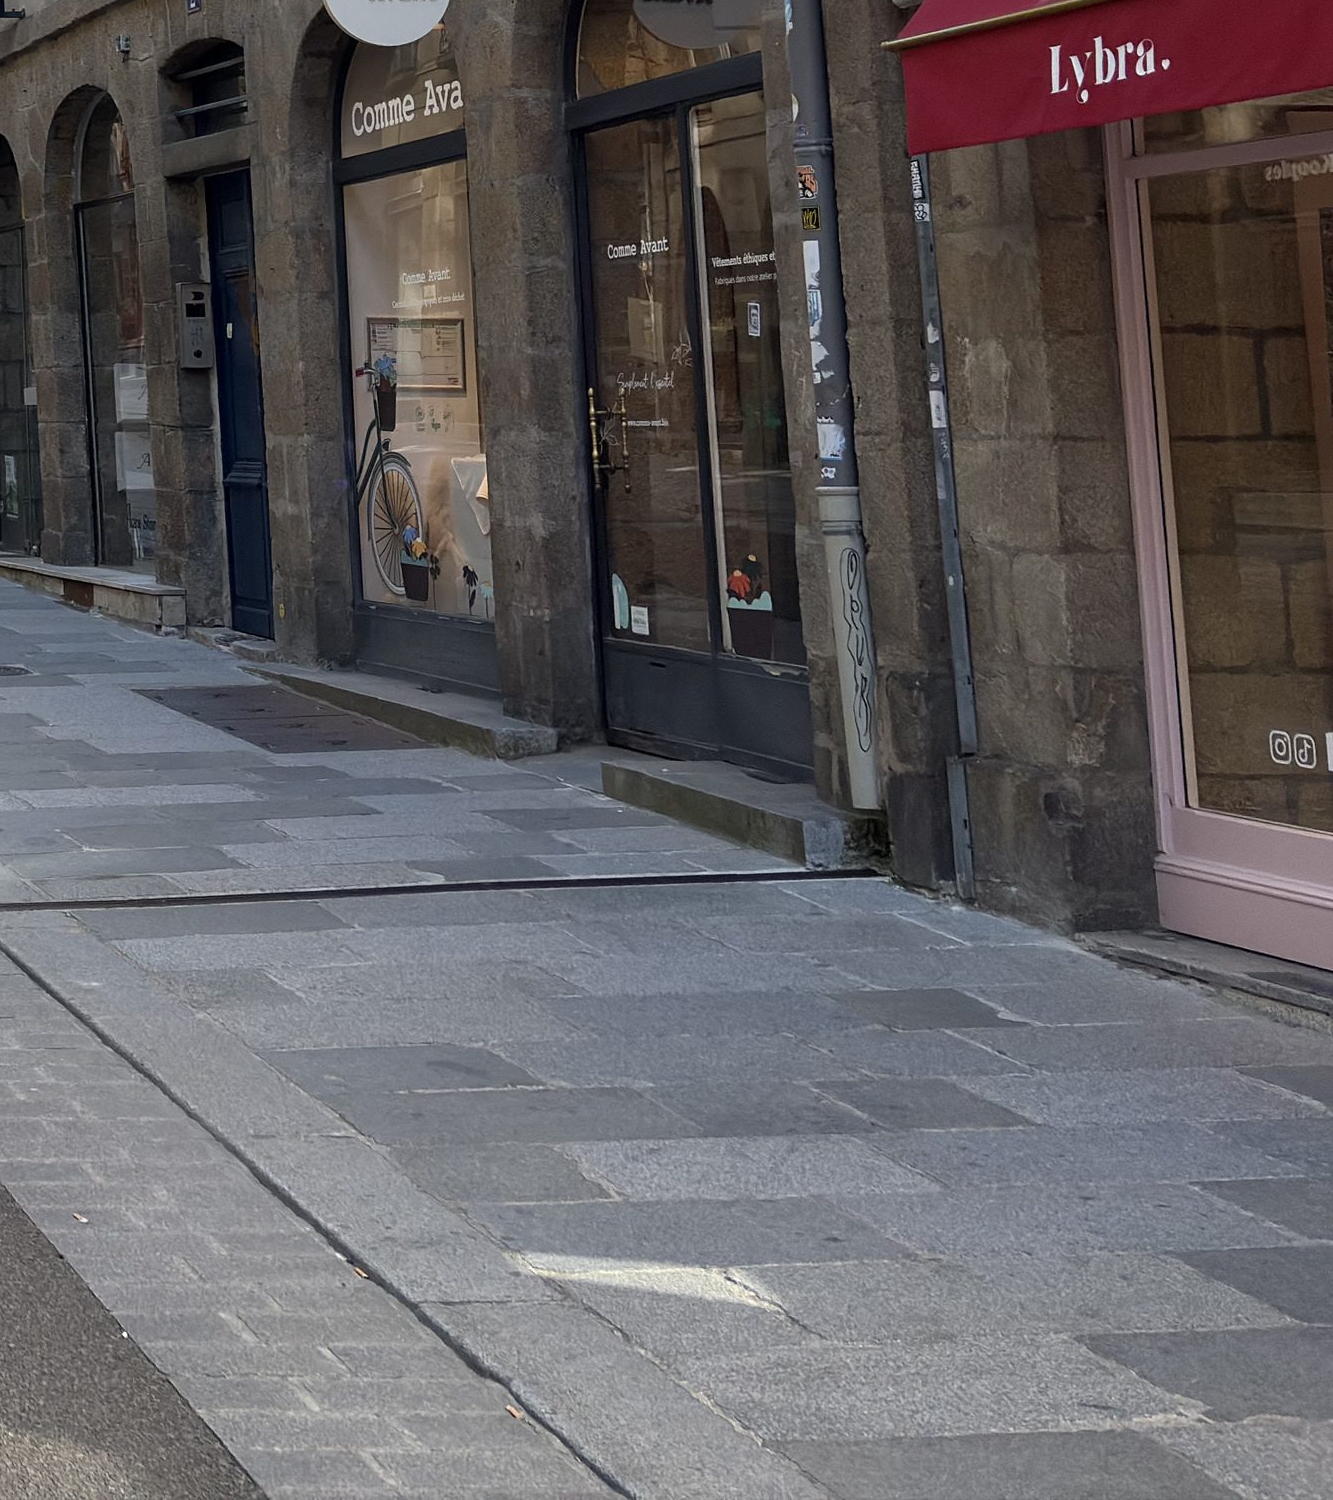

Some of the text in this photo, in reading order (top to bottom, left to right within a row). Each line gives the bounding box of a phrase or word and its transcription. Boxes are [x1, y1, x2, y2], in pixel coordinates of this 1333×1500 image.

[351, 79, 464, 137] Comme Ava
[607, 236, 669, 260] Comme Avant
[711, 255, 742, 268] Vêtements
[742, 251, 769, 266] éthiques
[402, 267, 451, 286] Comme Avant
